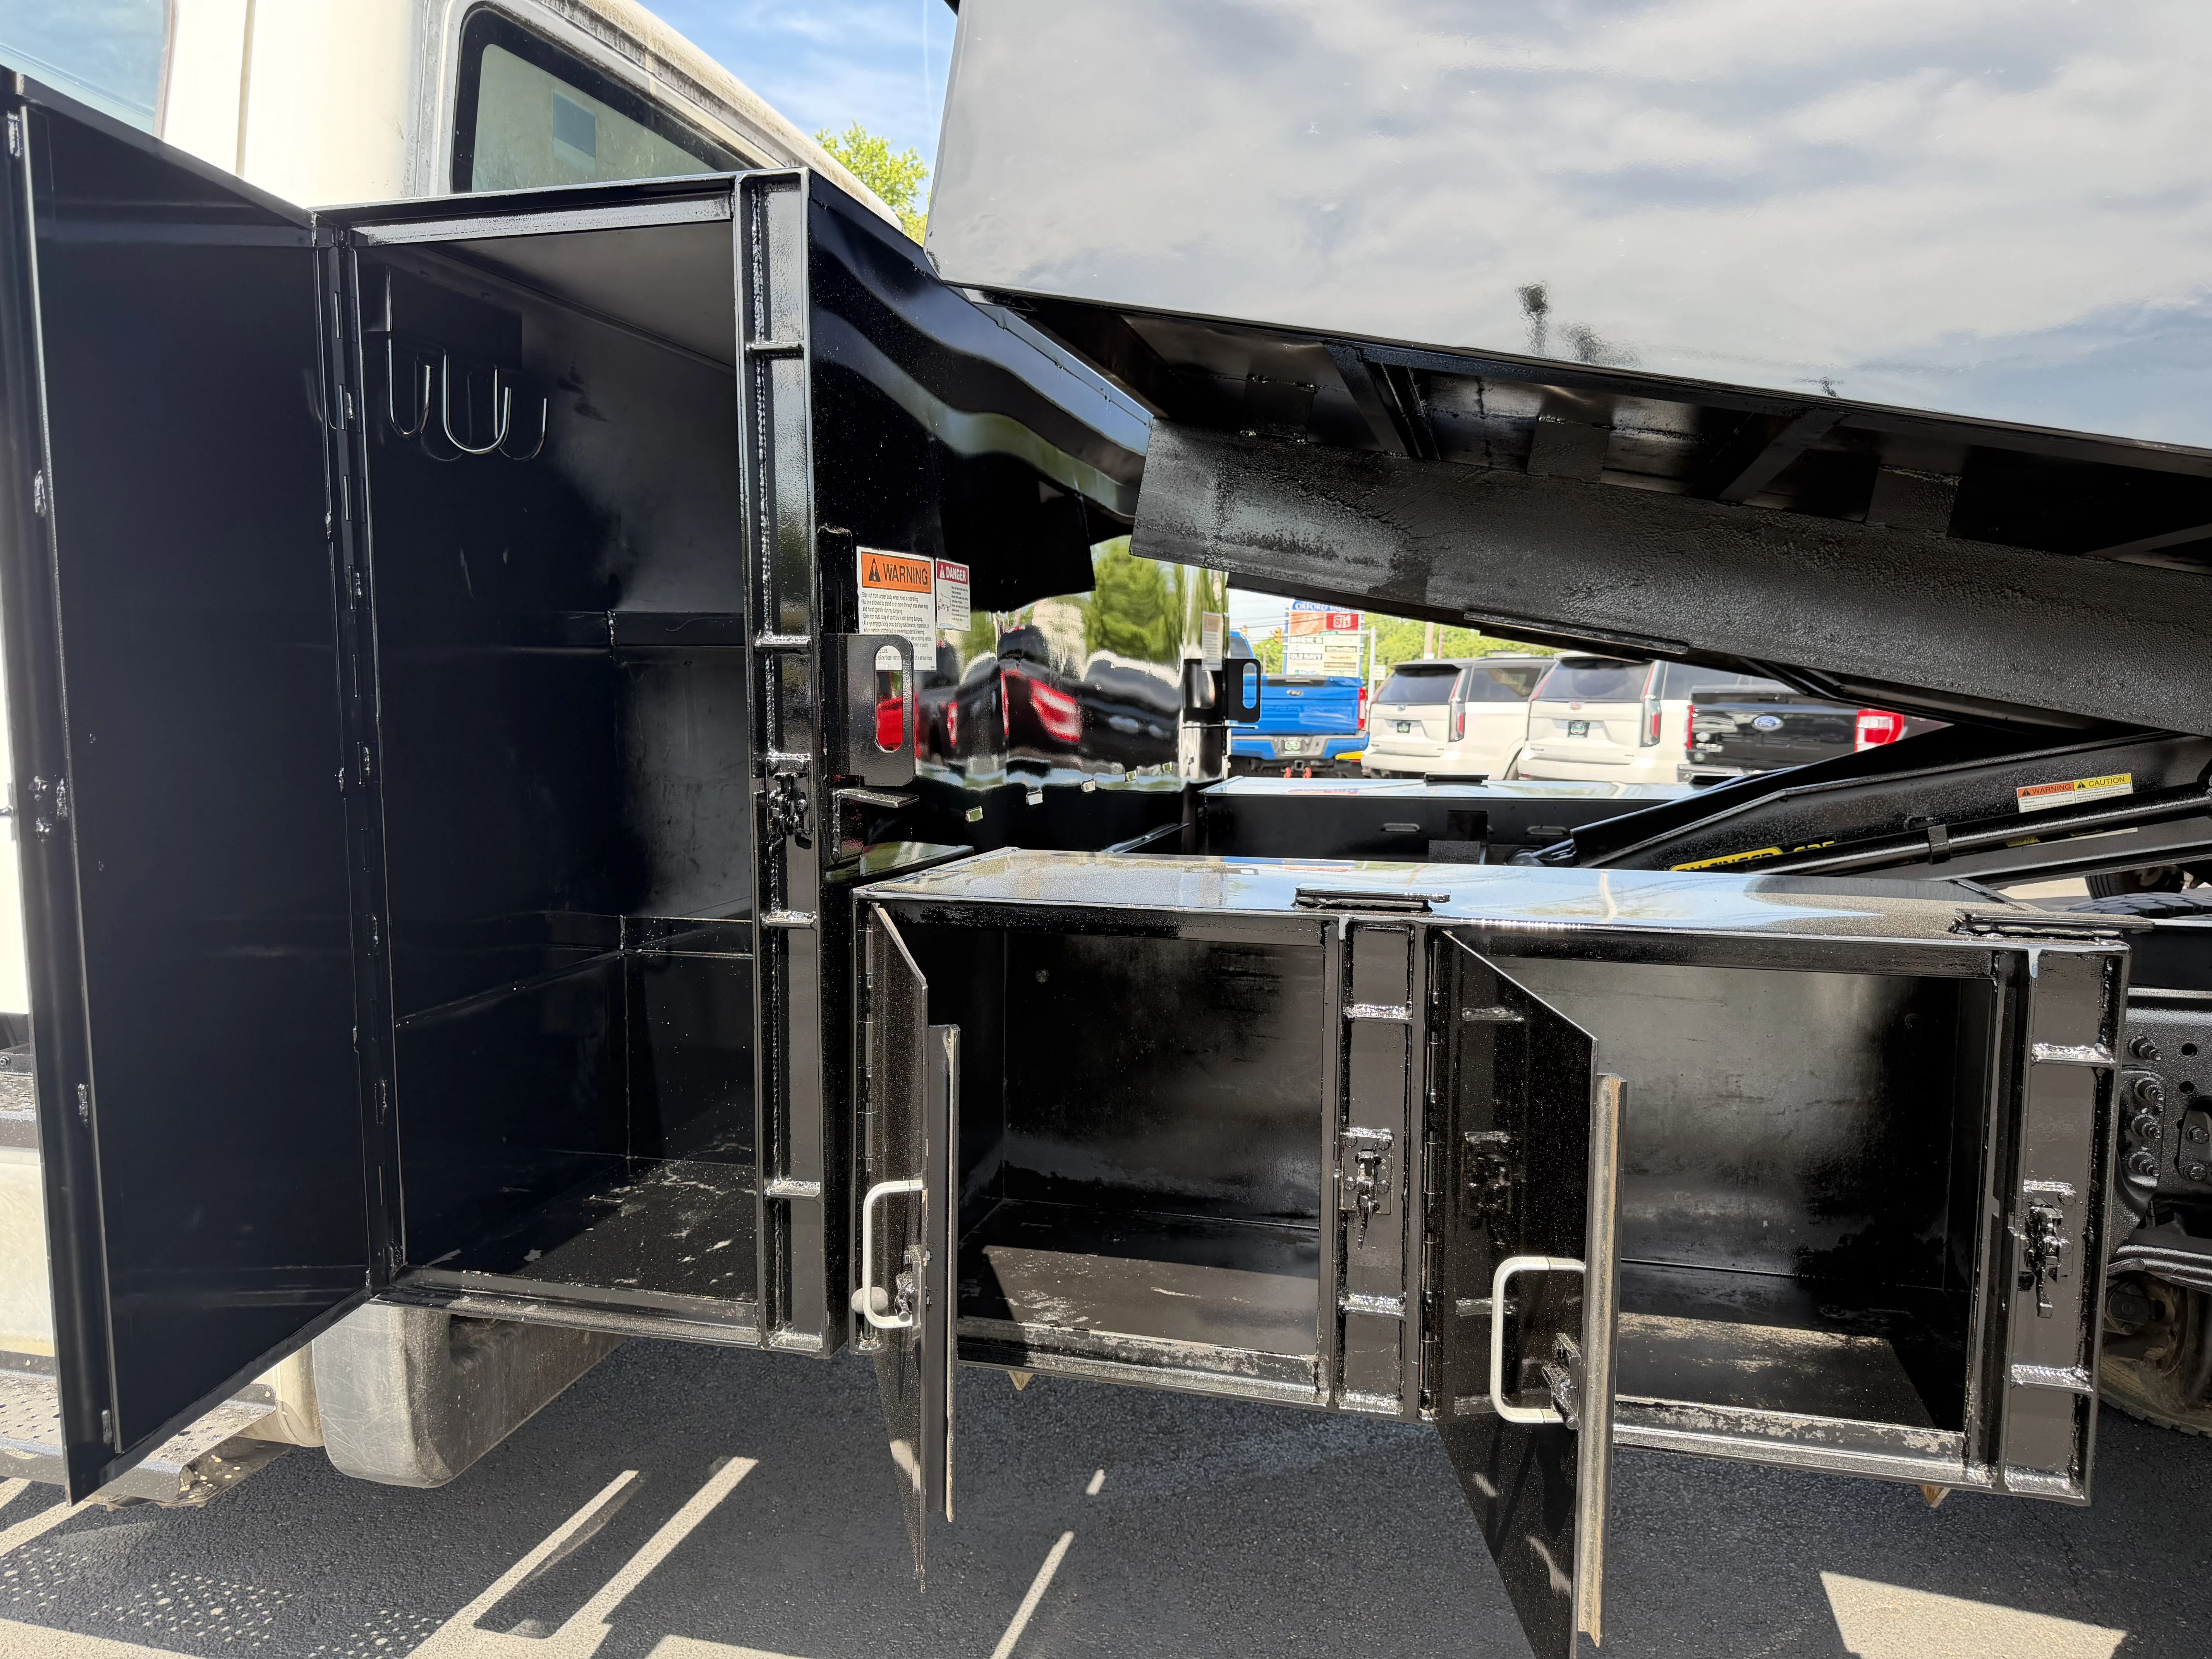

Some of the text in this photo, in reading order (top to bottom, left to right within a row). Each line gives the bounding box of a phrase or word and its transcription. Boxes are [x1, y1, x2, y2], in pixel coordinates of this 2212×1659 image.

[883, 562, 928, 586] WARNING
[946, 566, 966, 582] DANGER
[1295, 601, 1328, 611] OXFORD
[2088, 776, 2125, 787] CAUTION
[2032, 783, 2071, 794] WARNING
